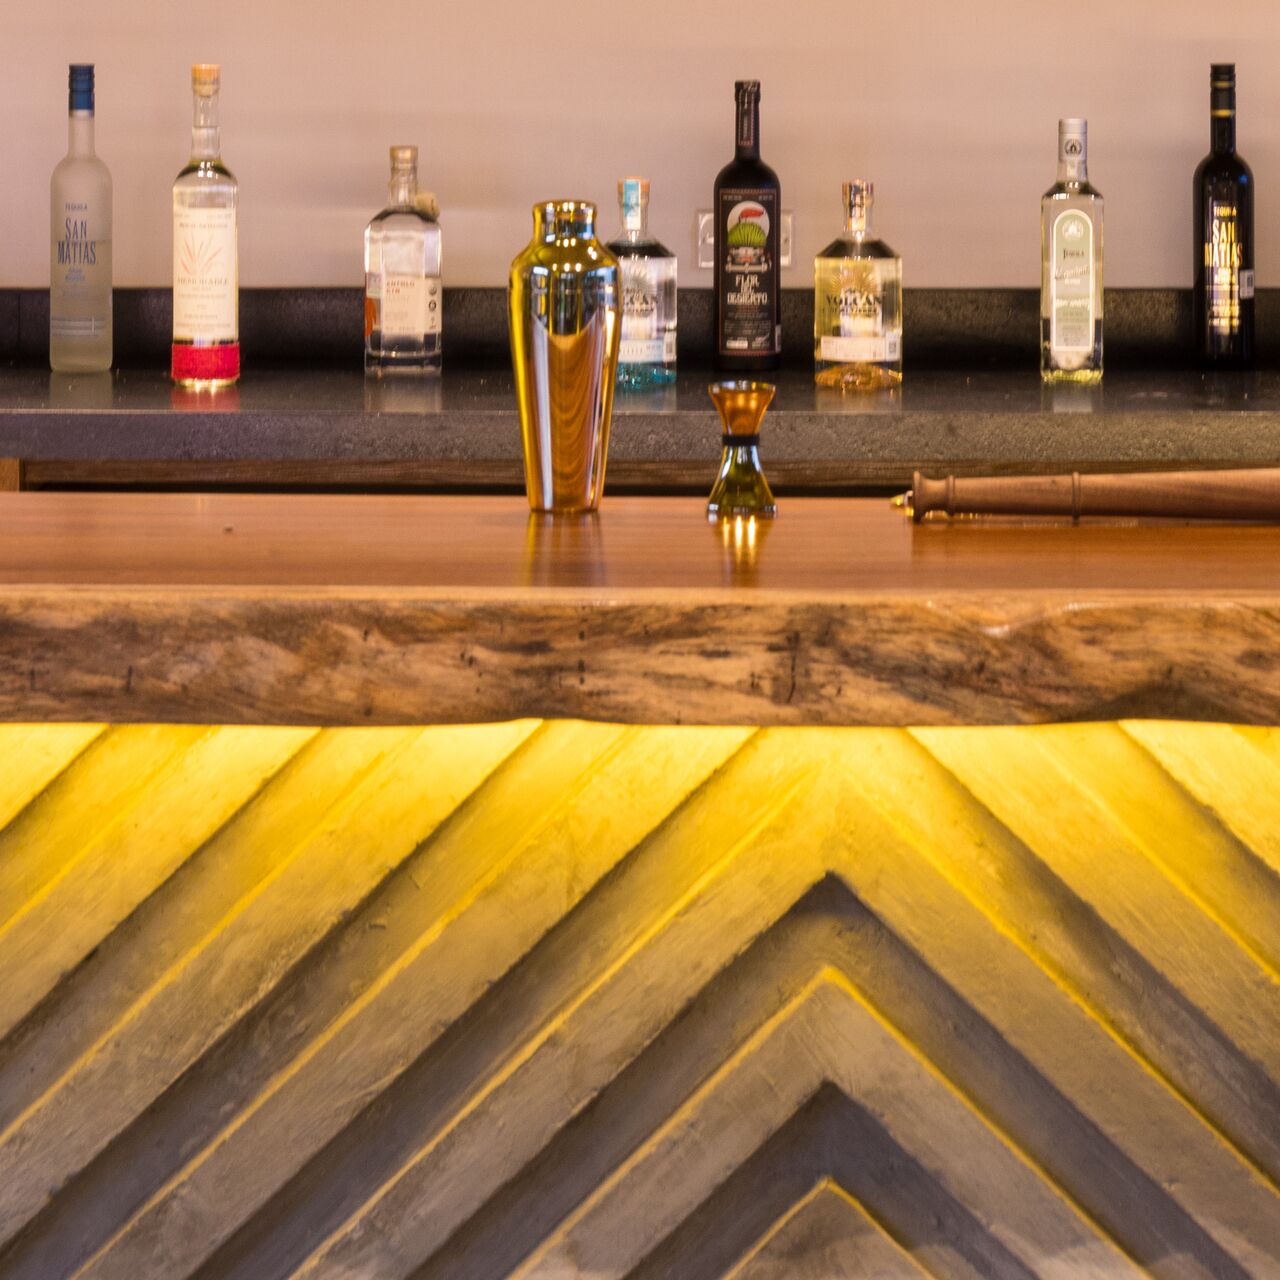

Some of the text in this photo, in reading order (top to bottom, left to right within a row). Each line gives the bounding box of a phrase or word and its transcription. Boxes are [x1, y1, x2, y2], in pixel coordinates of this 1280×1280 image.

[1213, 206, 1237, 217] TEQUILA
[65, 218, 87, 240] SAN
[1212, 219, 1235, 243] SAN
[735, 275, 760, 288] FLOR
